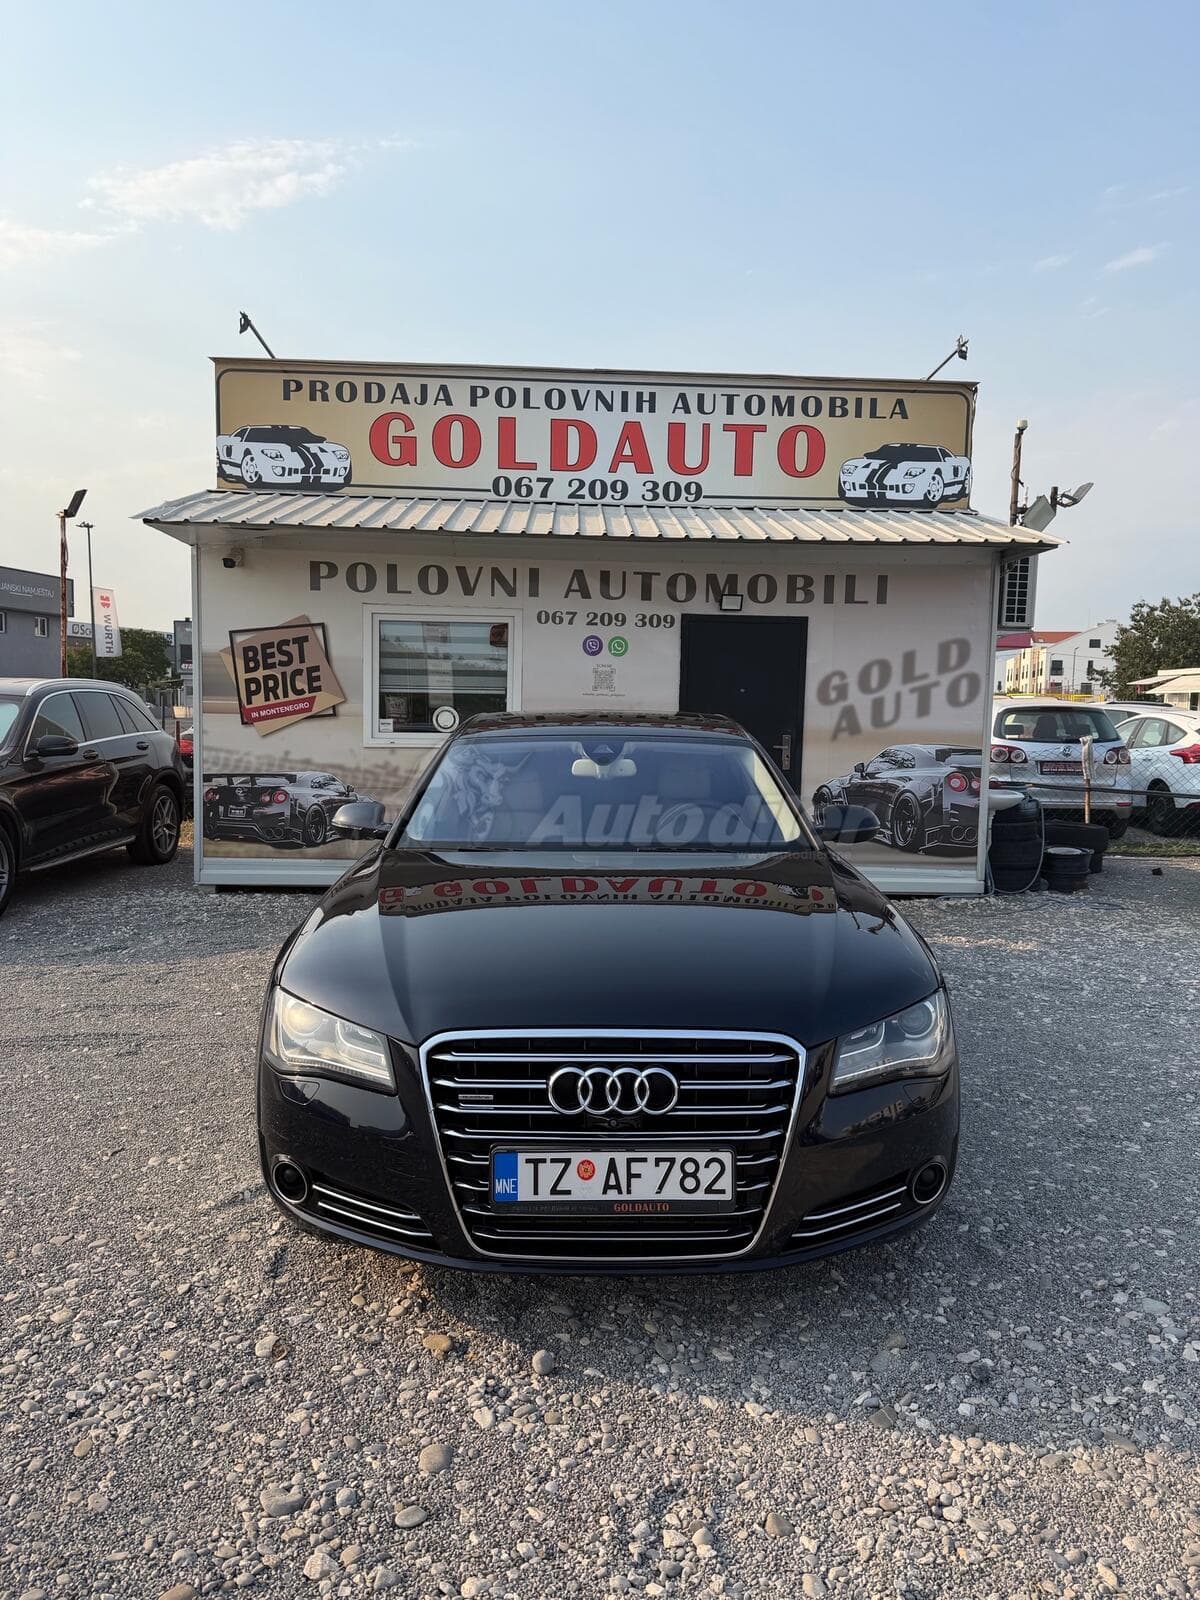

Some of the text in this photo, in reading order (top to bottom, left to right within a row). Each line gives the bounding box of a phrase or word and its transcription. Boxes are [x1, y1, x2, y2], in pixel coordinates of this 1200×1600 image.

[282, 378, 909, 420] PRODAJA POLOVNIH AUTOMOBILA
[368, 411, 826, 478] GOLDAUTO
[491, 475, 703, 502] 067 209 309
[309, 560, 888, 605] POLOVNI AUTOMOBILI
[536, 609, 675, 628] 067 209 309
[242, 635, 309, 673] BEST
[816, 637, 971, 706] GOLD
[244, 665, 322, 705] PRICE
[260, 702, 310, 717] MONTENEGRO
[831, 671, 981, 742] AUTO
[495, 1178, 517, 1195] MNE
[525, 1157, 726, 1196] TZ AF782
[613, 1202, 670, 1212] GOLDAUTO
